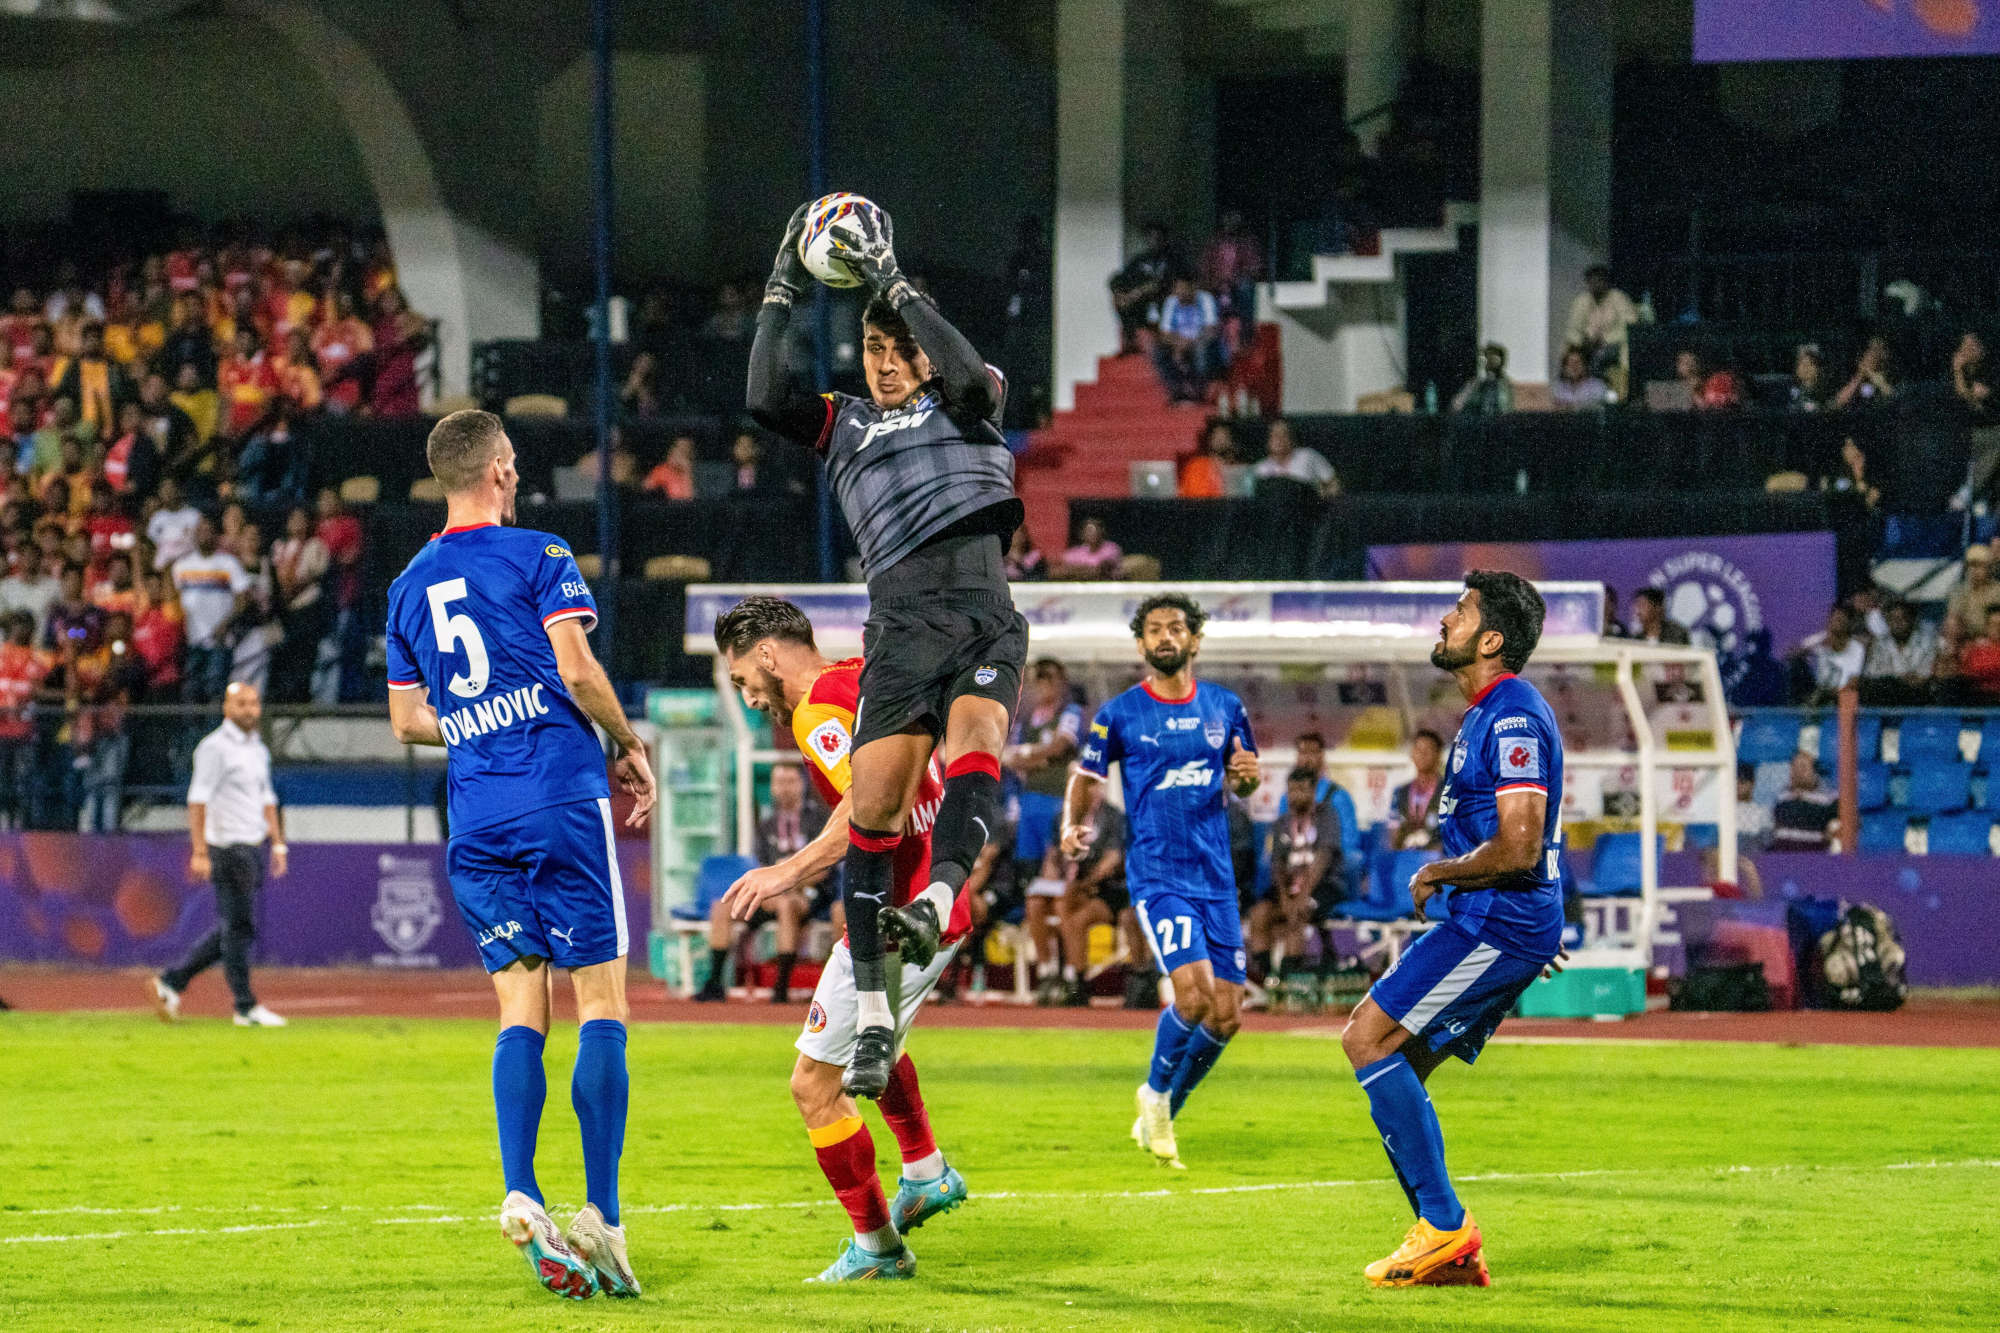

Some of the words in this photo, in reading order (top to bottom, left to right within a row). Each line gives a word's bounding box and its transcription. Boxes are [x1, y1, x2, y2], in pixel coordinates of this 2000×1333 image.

[856, 409, 934, 452] JSW
[426, 577, 490, 698] 5
[438, 683, 550, 747] OVANOVIC
[1155, 759, 1214, 790] JSW
[1157, 916, 1192, 956] 27
